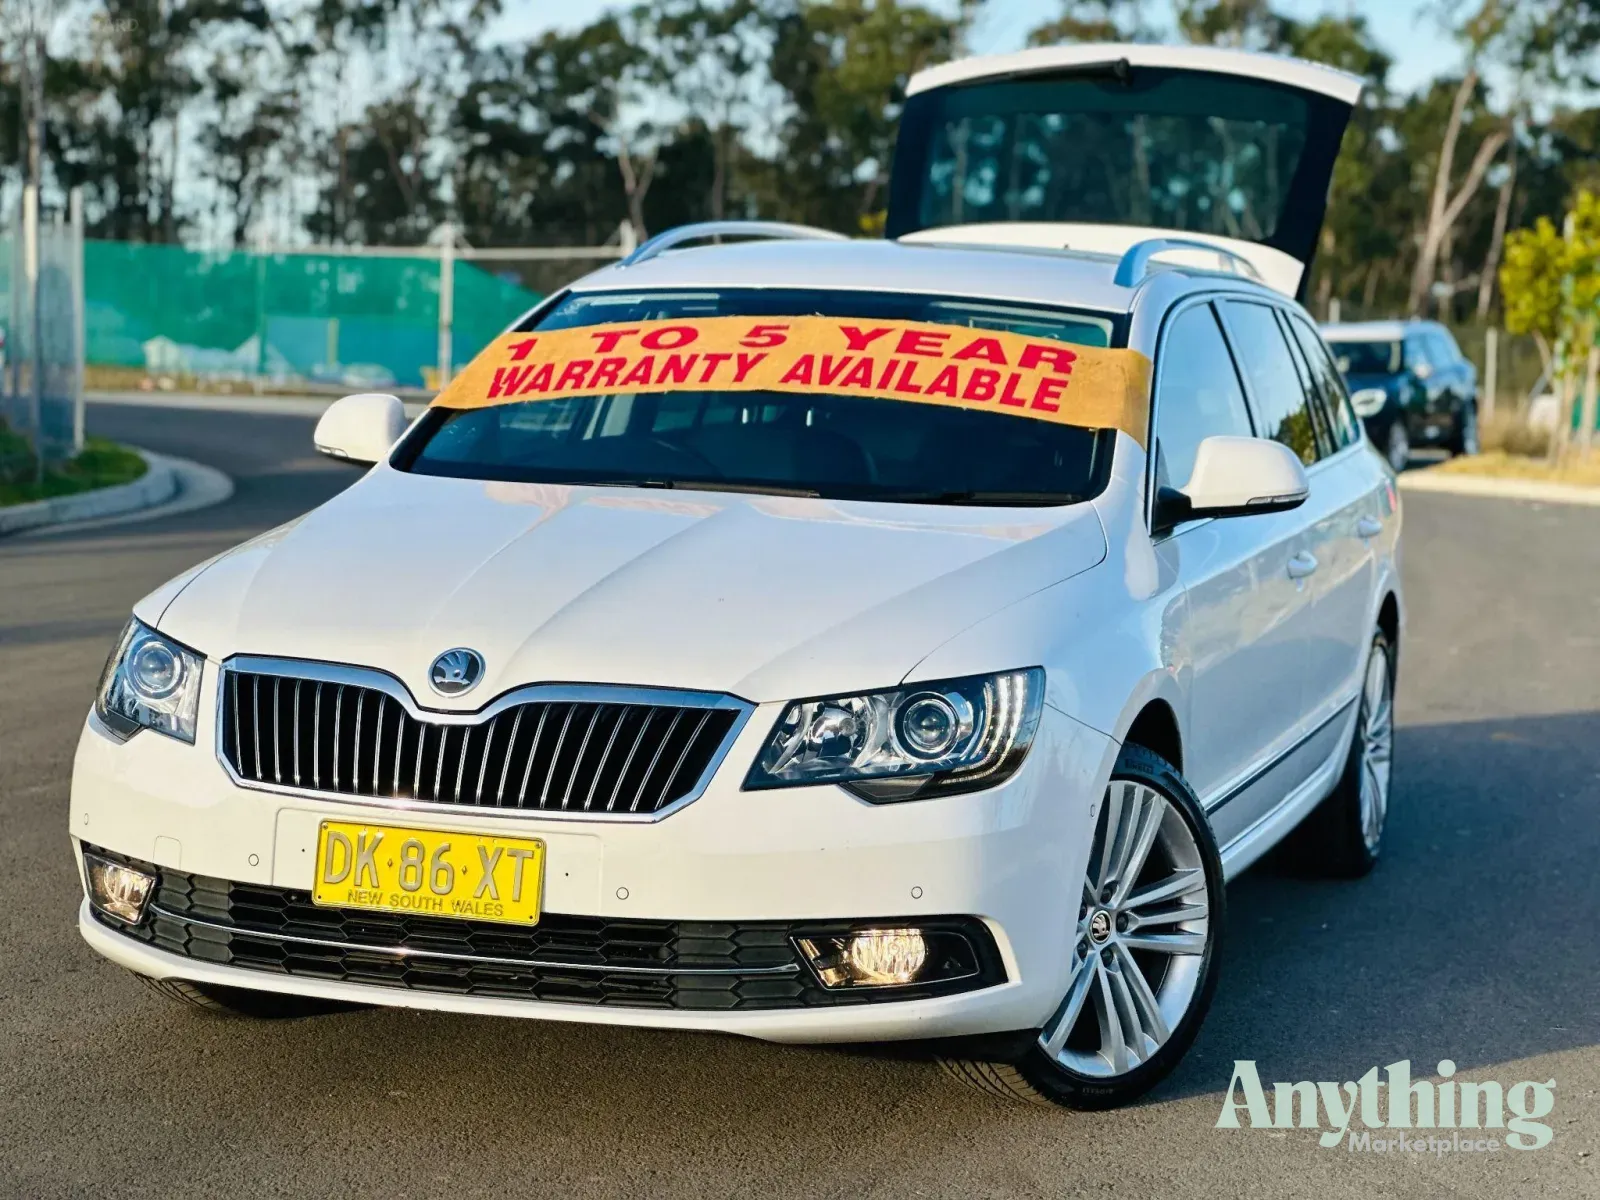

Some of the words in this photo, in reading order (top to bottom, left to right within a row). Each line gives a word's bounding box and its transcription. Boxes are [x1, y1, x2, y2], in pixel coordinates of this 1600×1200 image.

[507, 337, 538, 362] 1
[592, 325, 700, 355] TO
[741, 324, 789, 349] 5
[839, 325, 1078, 376] YEAR
[487, 352, 767, 399] WARRANTY
[779, 353, 1069, 413] AVAILABLE
[347, 889, 383, 905] NEW
[388, 892, 443, 912] SOUTH
[450, 900, 504, 917] WALES
